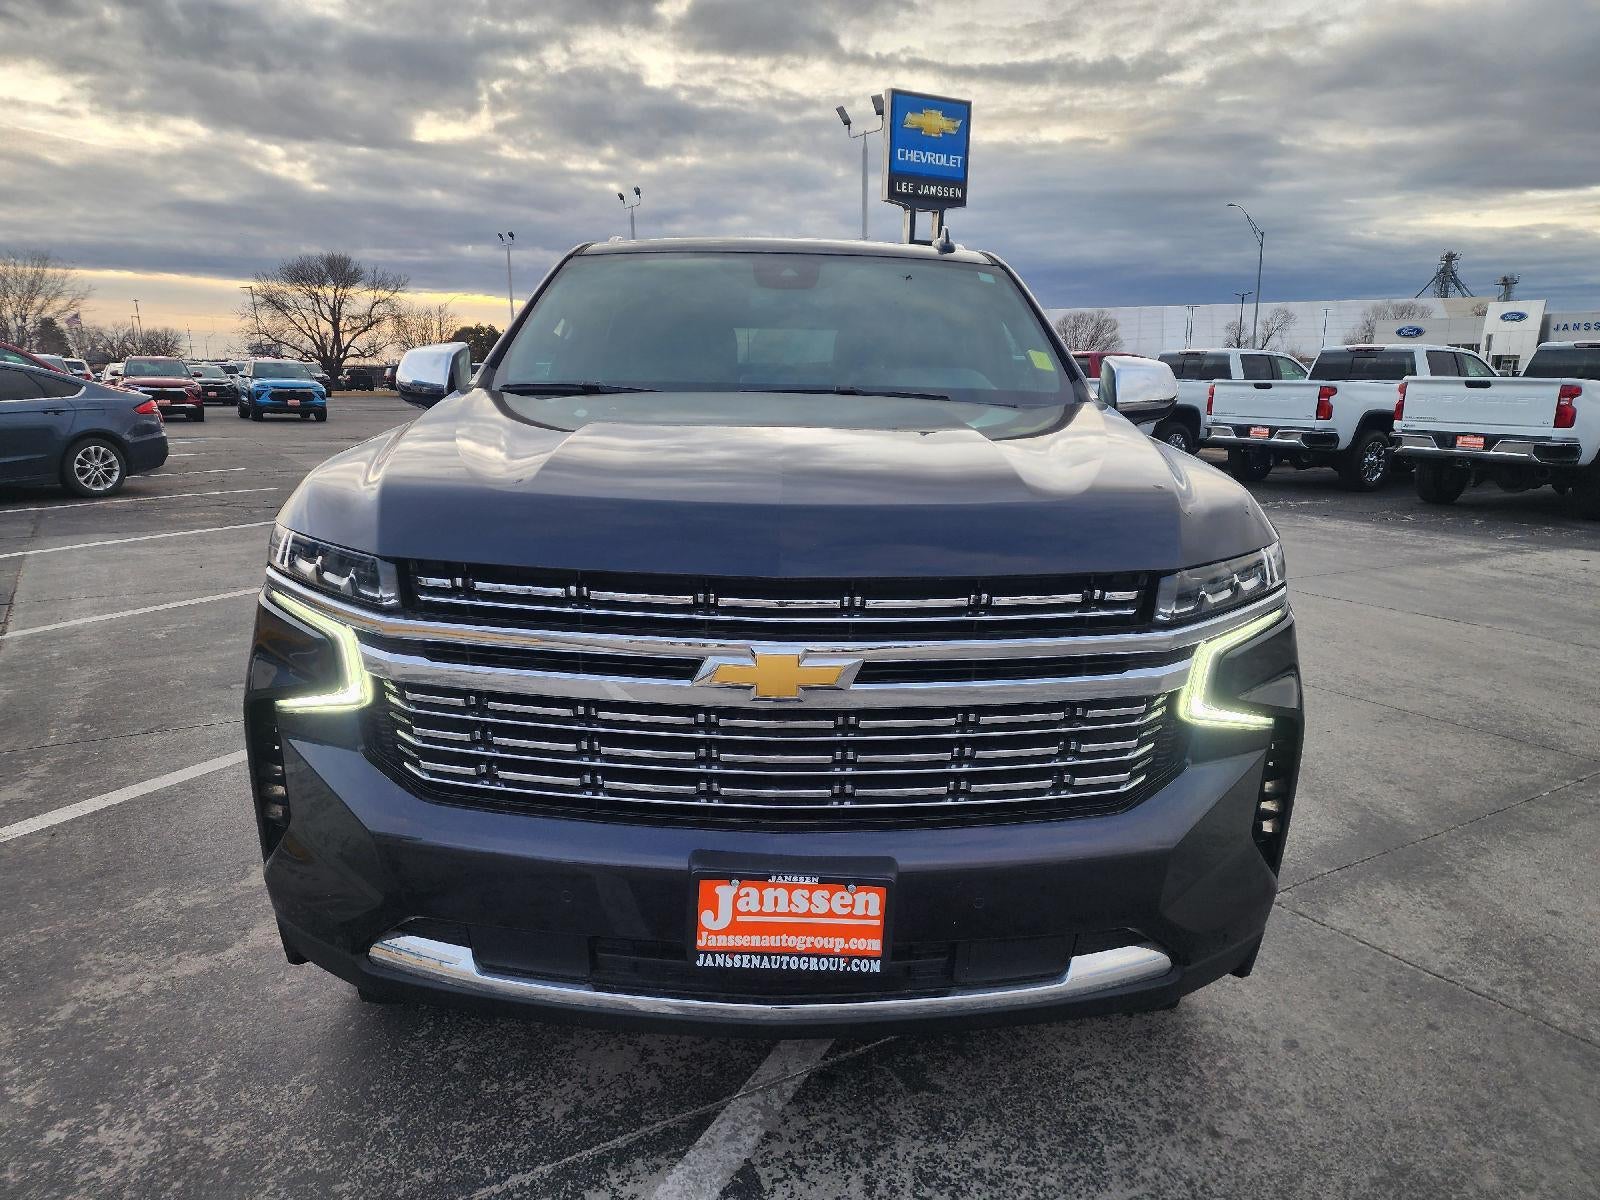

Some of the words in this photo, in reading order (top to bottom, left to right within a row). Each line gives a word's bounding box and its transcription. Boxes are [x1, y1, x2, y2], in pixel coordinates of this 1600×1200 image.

[897, 148, 963, 168] CHEVROLET
[896, 182, 914, 193] LEE
[918, 185, 962, 198] JANSSEN
[1553, 322, 1600, 331] JANSS
[768, 875, 820, 883] JANSSEN
[701, 884, 881, 930] Janssen
[697, 932, 881, 952] Janssenautogroup.com
[696, 953, 881, 973] JANSSENAUTOGROUP.COM
